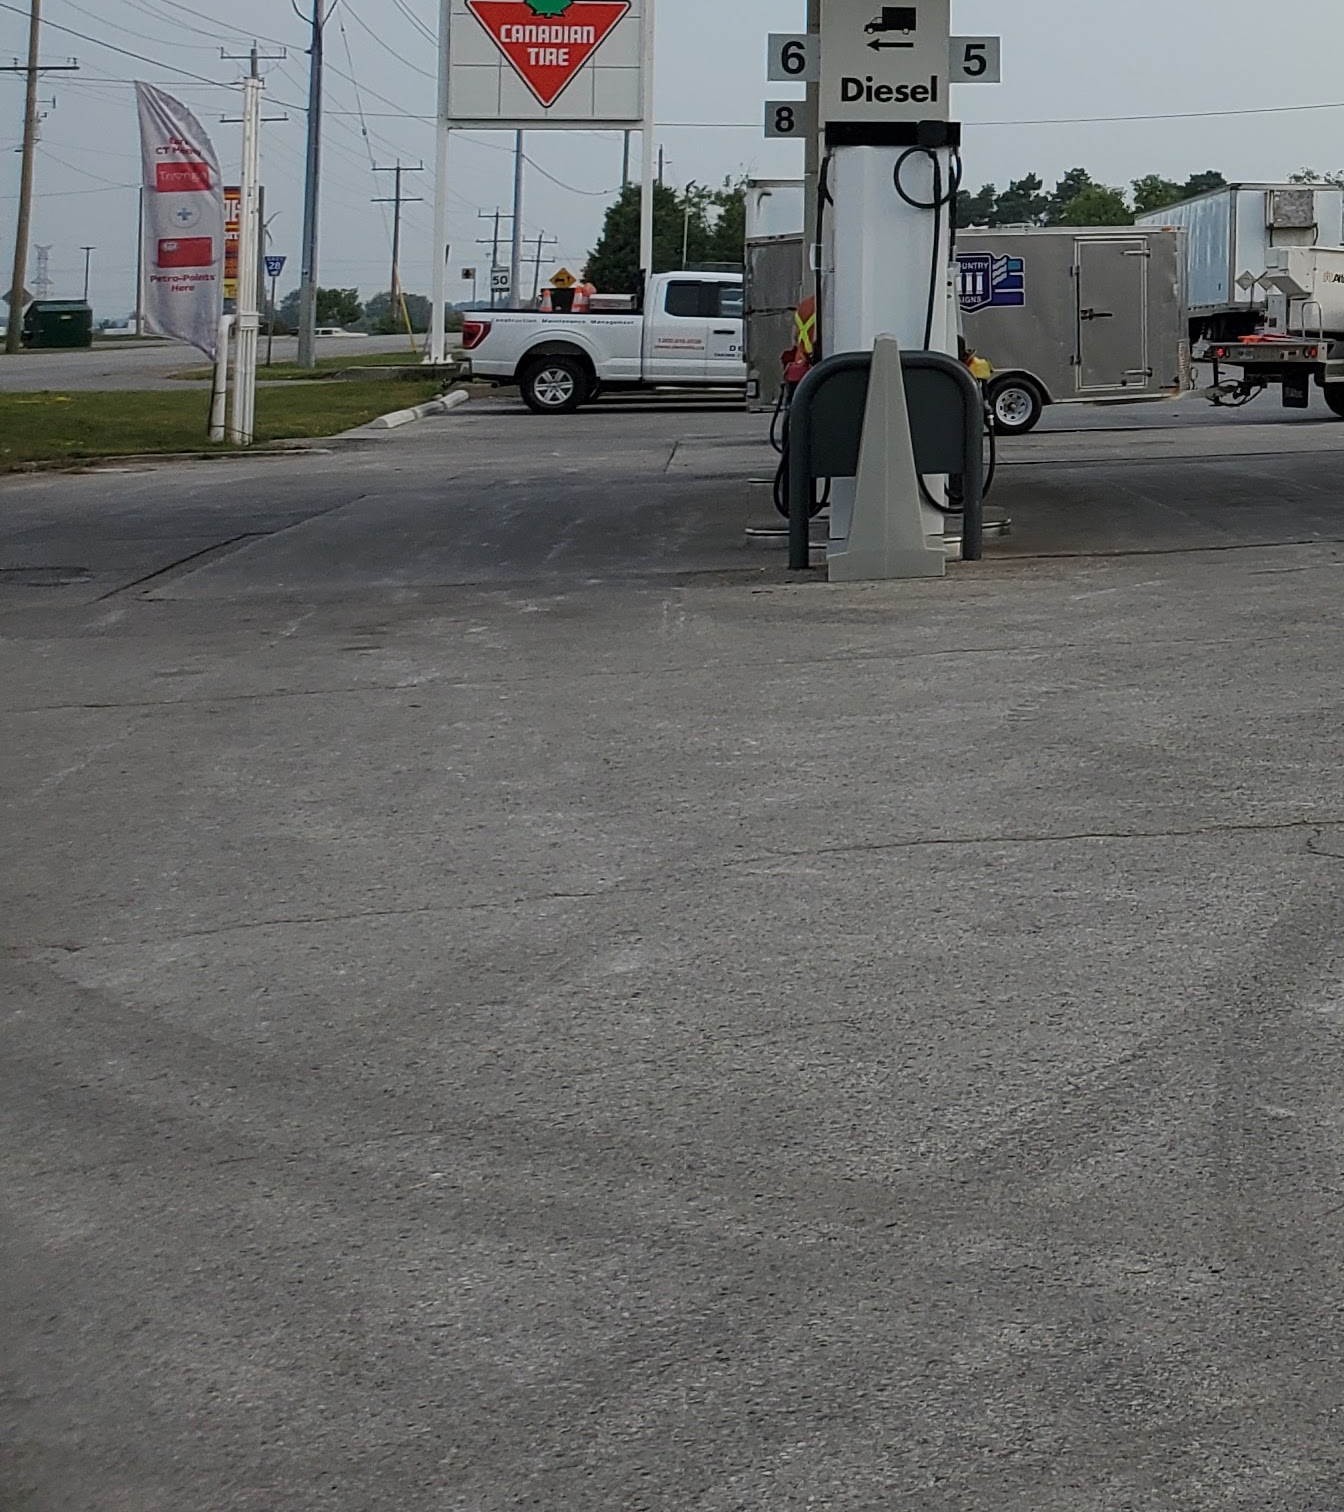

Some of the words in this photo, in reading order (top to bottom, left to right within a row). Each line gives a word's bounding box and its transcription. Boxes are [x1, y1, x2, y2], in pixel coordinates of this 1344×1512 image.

[500, 24, 595, 44] CANADIAN
[527, 47, 570, 66] TIRE
[780, 40, 806, 74] 6
[962, 43, 987, 76] 5
[841, 75, 938, 103] Diesel
[775, 106, 795, 133] 8
[268, 261, 281, 270] 28
[960, 262, 989, 270] UNTRY
[171, 284, 195, 292] Here
[492, 275, 508, 285] 50
